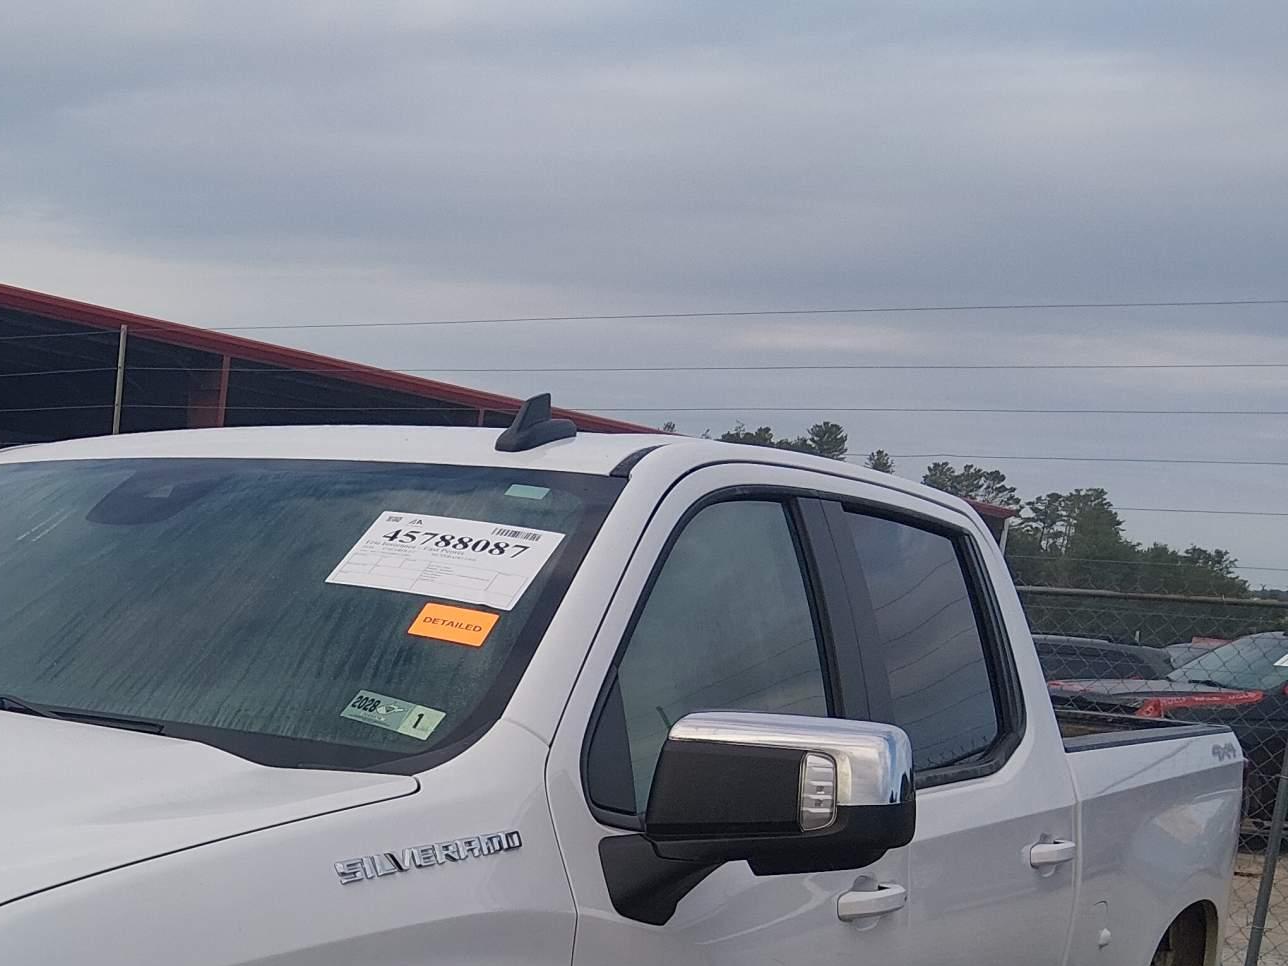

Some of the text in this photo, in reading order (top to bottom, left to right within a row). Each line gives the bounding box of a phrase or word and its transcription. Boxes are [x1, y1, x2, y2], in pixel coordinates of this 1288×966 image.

[382, 528, 530, 559] 45788087
[422, 615, 483, 633] DETAILED
[351, 695, 381, 713] 2028
[412, 713, 425, 729] 1
[333, 829, 523, 885] SILVERADO
